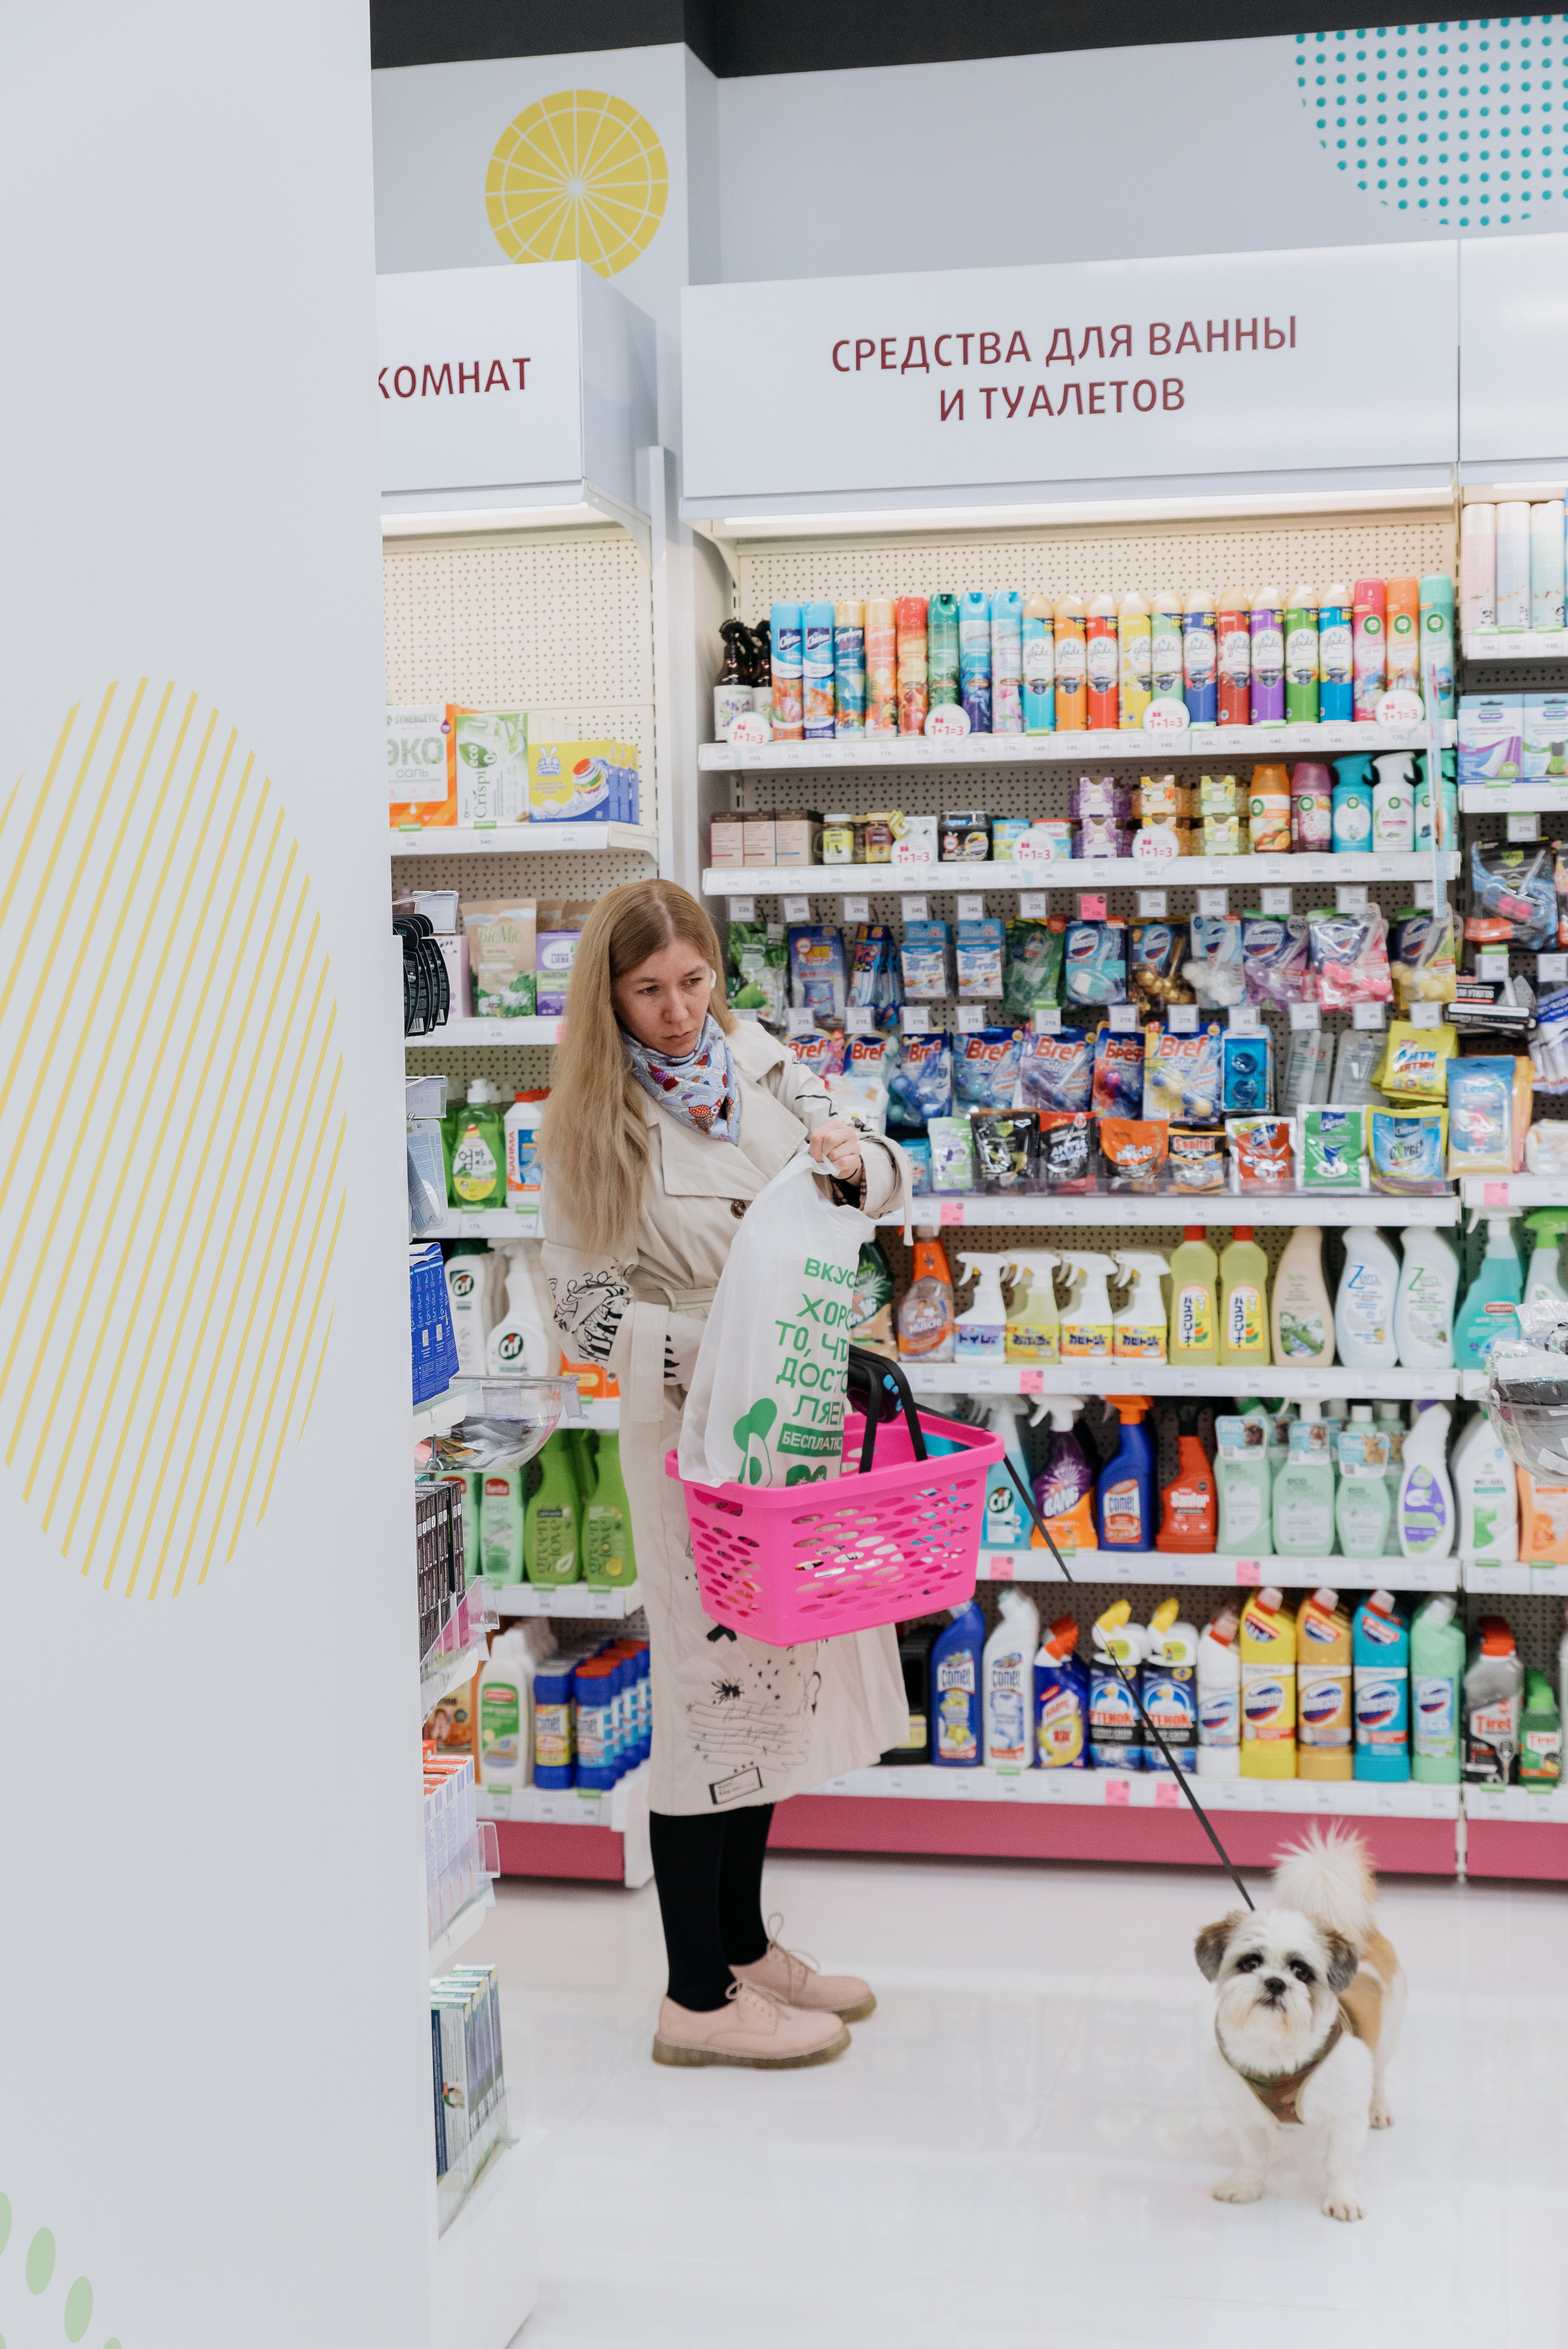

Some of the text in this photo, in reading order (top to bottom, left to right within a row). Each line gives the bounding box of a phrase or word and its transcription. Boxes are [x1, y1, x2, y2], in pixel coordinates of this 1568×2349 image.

[832, 316, 1295, 374] СРЕДСТВА ДЛЯ ВАННЫ
[940, 378, 1185, 422] И ТУАЛЕТОВ
[1058, 646, 1083, 660] glade
[1090, 645, 1114, 660] glade
[1134, 645, 1152, 660] gla
[1154, 645, 1178, 660] glade
[1186, 643, 1210, 659] glade
[1228, 641, 1250, 656] glade
[1256, 639, 1282, 656] glade
[1291, 638, 1315, 655] glade
[1324, 637, 1347, 653] glade
[1027, 646, 1051, 662] glade
[395, 714, 439, 724] SYNERGETIC
[1150, 718, 1183, 728] 1+1=3
[1384, 710, 1418, 721] 1+1=3
[733, 732, 764, 744] 1+1=3
[932, 726, 963, 735] 1+1=3
[387, 737, 443, 766] ЭКО
[469, 744, 479, 766] eco
[396, 768, 429, 777] СОЛЬ
[474, 771, 490, 818] Crispi
[897, 853, 929, 863] 1+1=3
[1019, 850, 1050, 860] 1+1=3
[1140, 848, 1172, 857] 1+1=3
[851, 1041, 886, 1061] Bref
[965, 1038, 1013, 1061] Bref
[1035, 1037, 1086, 1062] Bref
[1159, 1035, 1209, 1057] Bref
[1348, 1265, 1378, 1289] Zero
[1409, 1268, 1439, 1291] Zero
[454, 1279, 473, 1294] Cif
[501, 1336, 522, 1356] Cif
[775, 1320, 812, 1358] ТО,
[989, 1490, 1011, 1511] Cif
[1044, 1486, 1079, 1518] BANG
[1477, 1715, 1511, 1734] Tiret
